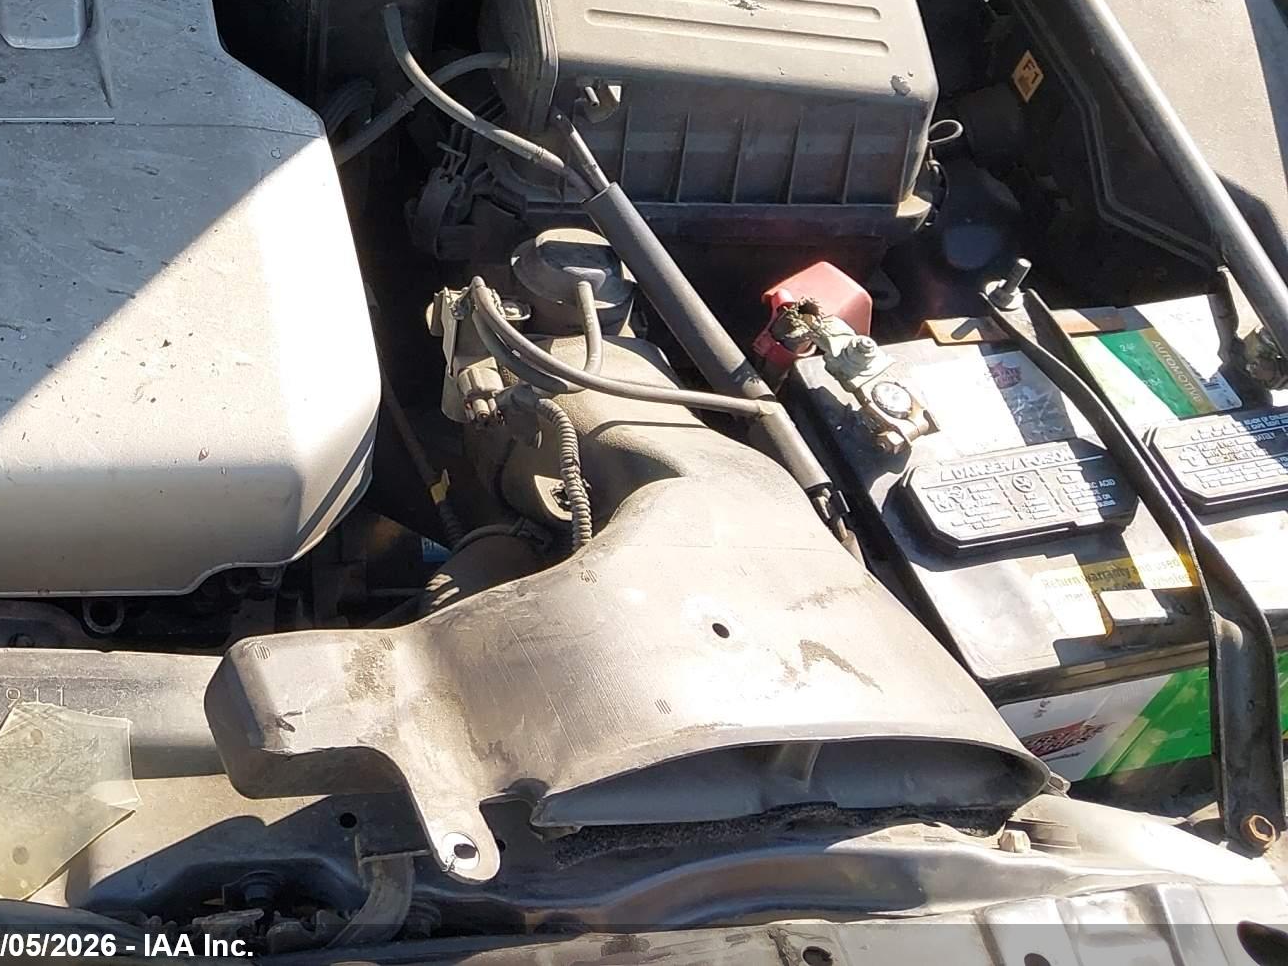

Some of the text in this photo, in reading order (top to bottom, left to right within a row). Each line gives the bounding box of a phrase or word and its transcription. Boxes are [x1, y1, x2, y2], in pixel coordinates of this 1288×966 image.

[1151, 340, 1202, 403] AUTOMOTIVE
[1041, 574, 1081, 589] Return
[1082, 567, 1130, 584] warranty
